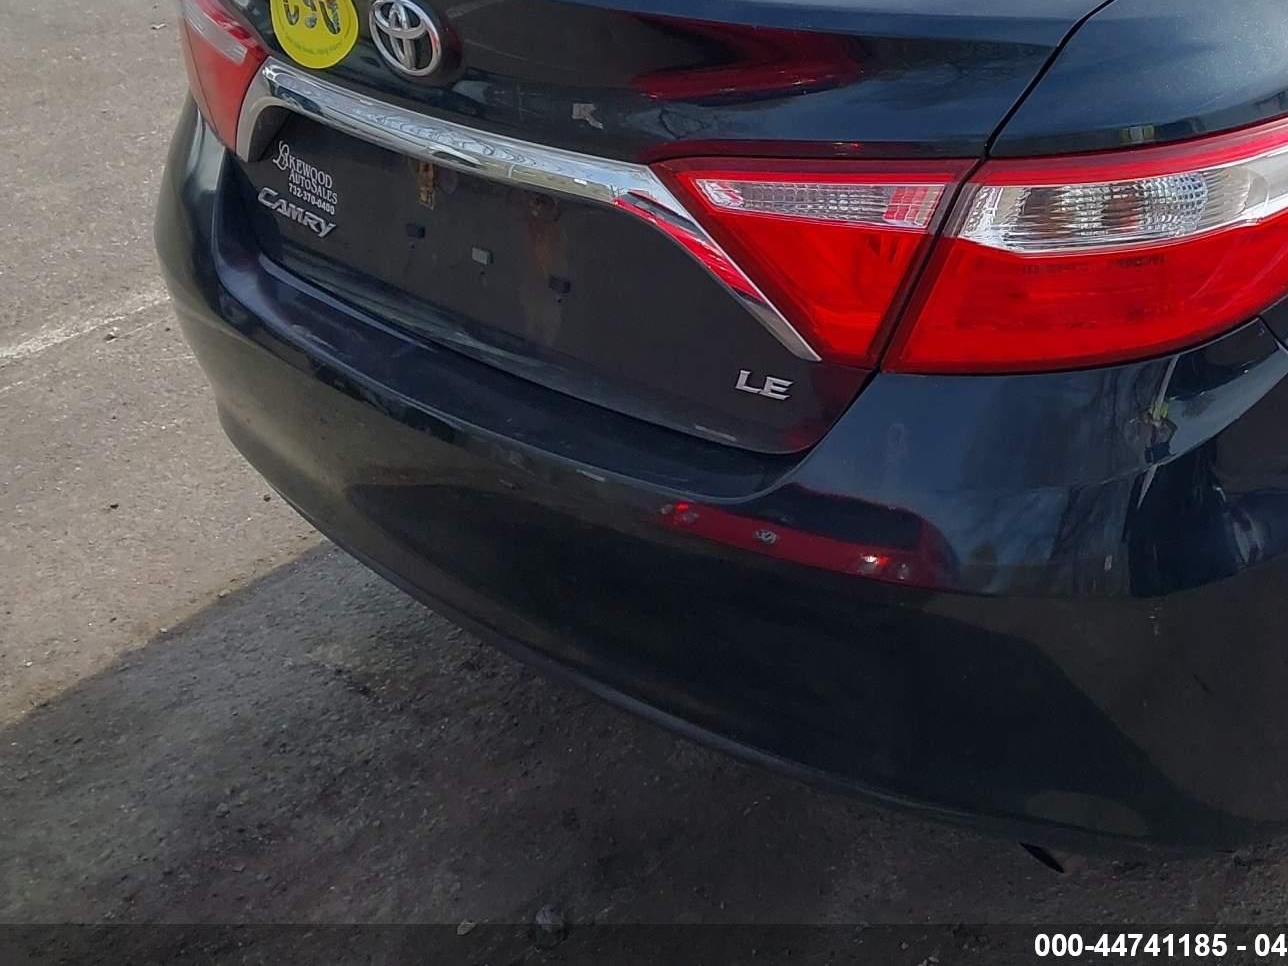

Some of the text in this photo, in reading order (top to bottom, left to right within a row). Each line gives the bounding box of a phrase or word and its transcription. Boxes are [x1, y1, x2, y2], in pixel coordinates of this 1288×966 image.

[273, 140, 333, 189] LAKEWOOD
[257, 186, 337, 238] CAMRY
[735, 369, 795, 401] LE
